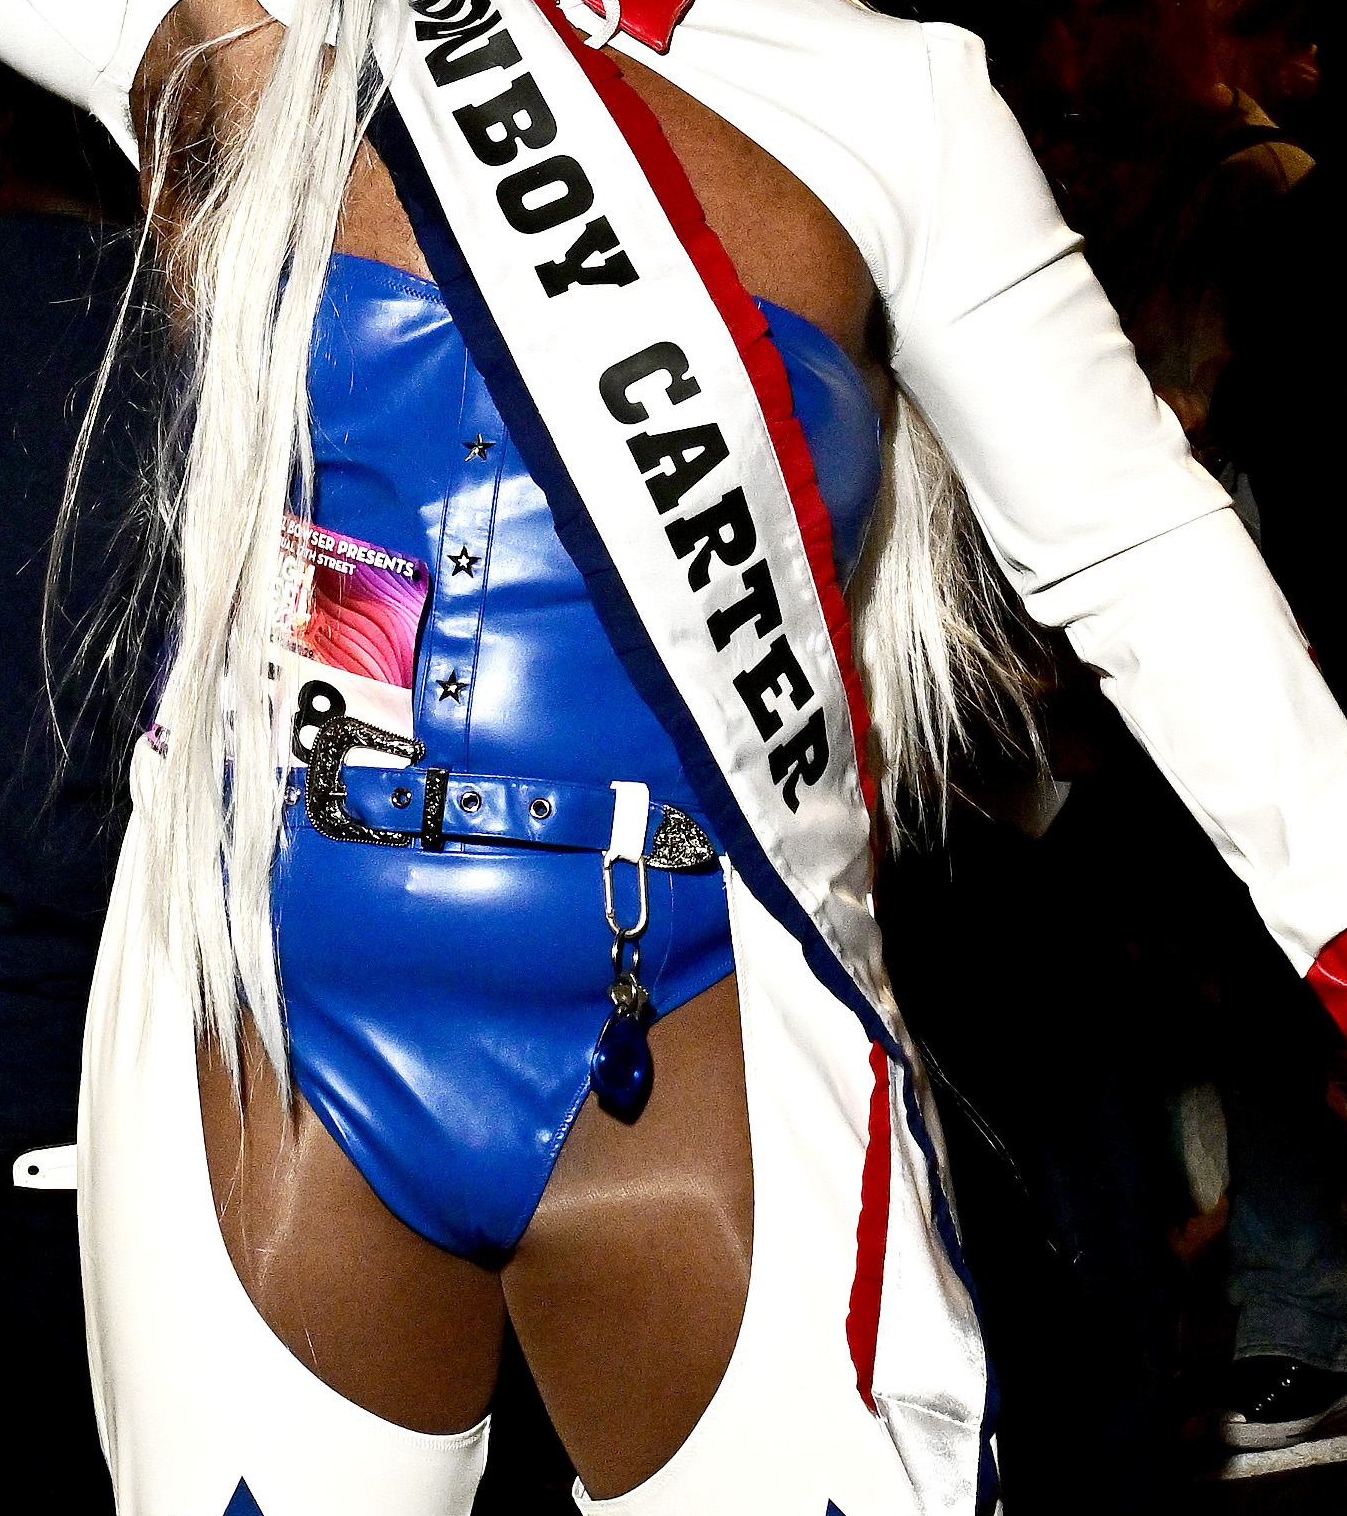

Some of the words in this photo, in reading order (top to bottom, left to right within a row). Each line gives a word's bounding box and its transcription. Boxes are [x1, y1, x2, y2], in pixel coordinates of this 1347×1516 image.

[316, 554, 357, 576] STREET
[336, 540, 415, 578] PRESENTS
[599, 341, 831, 815] CARTER
